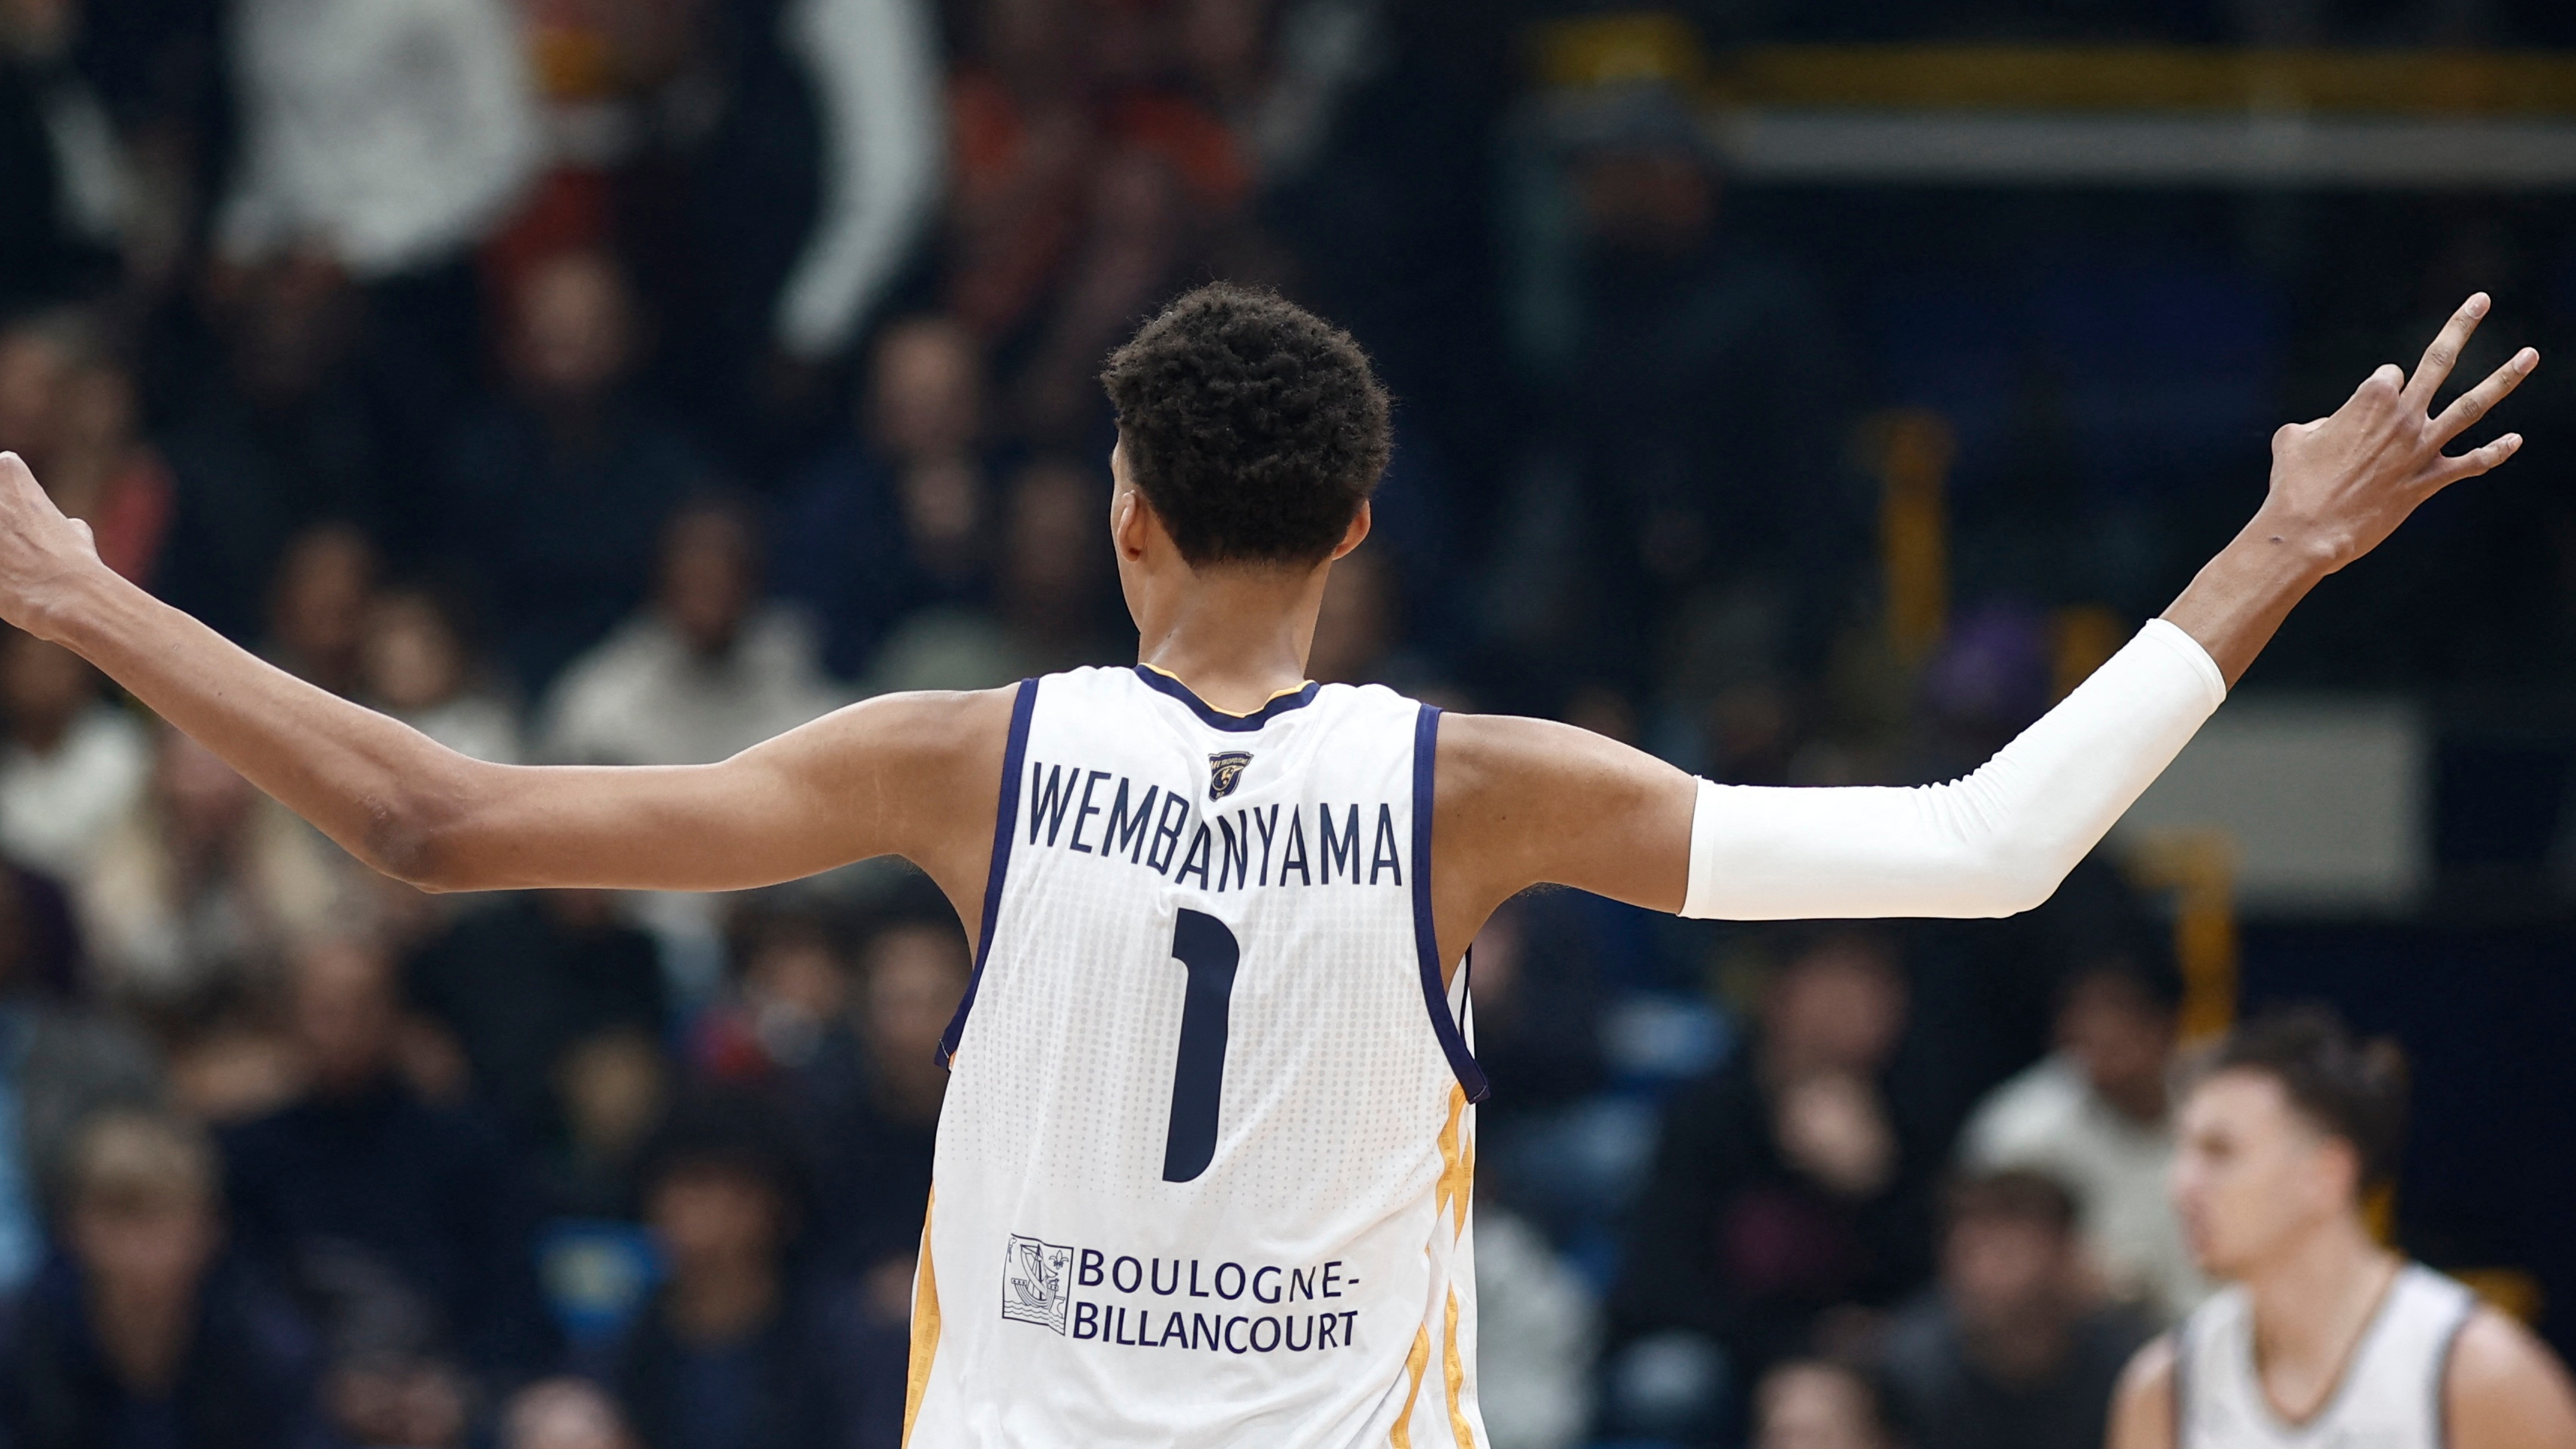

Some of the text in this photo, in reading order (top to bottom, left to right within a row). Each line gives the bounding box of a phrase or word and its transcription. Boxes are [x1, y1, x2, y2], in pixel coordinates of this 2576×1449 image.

[1029, 762, 1402, 892] WEMBANYAMA
[1163, 908, 1240, 1183] 1
[1077, 1249, 1361, 1304] BOULOGNE-
[1072, 1301, 1359, 1354] BILLANCOURT
